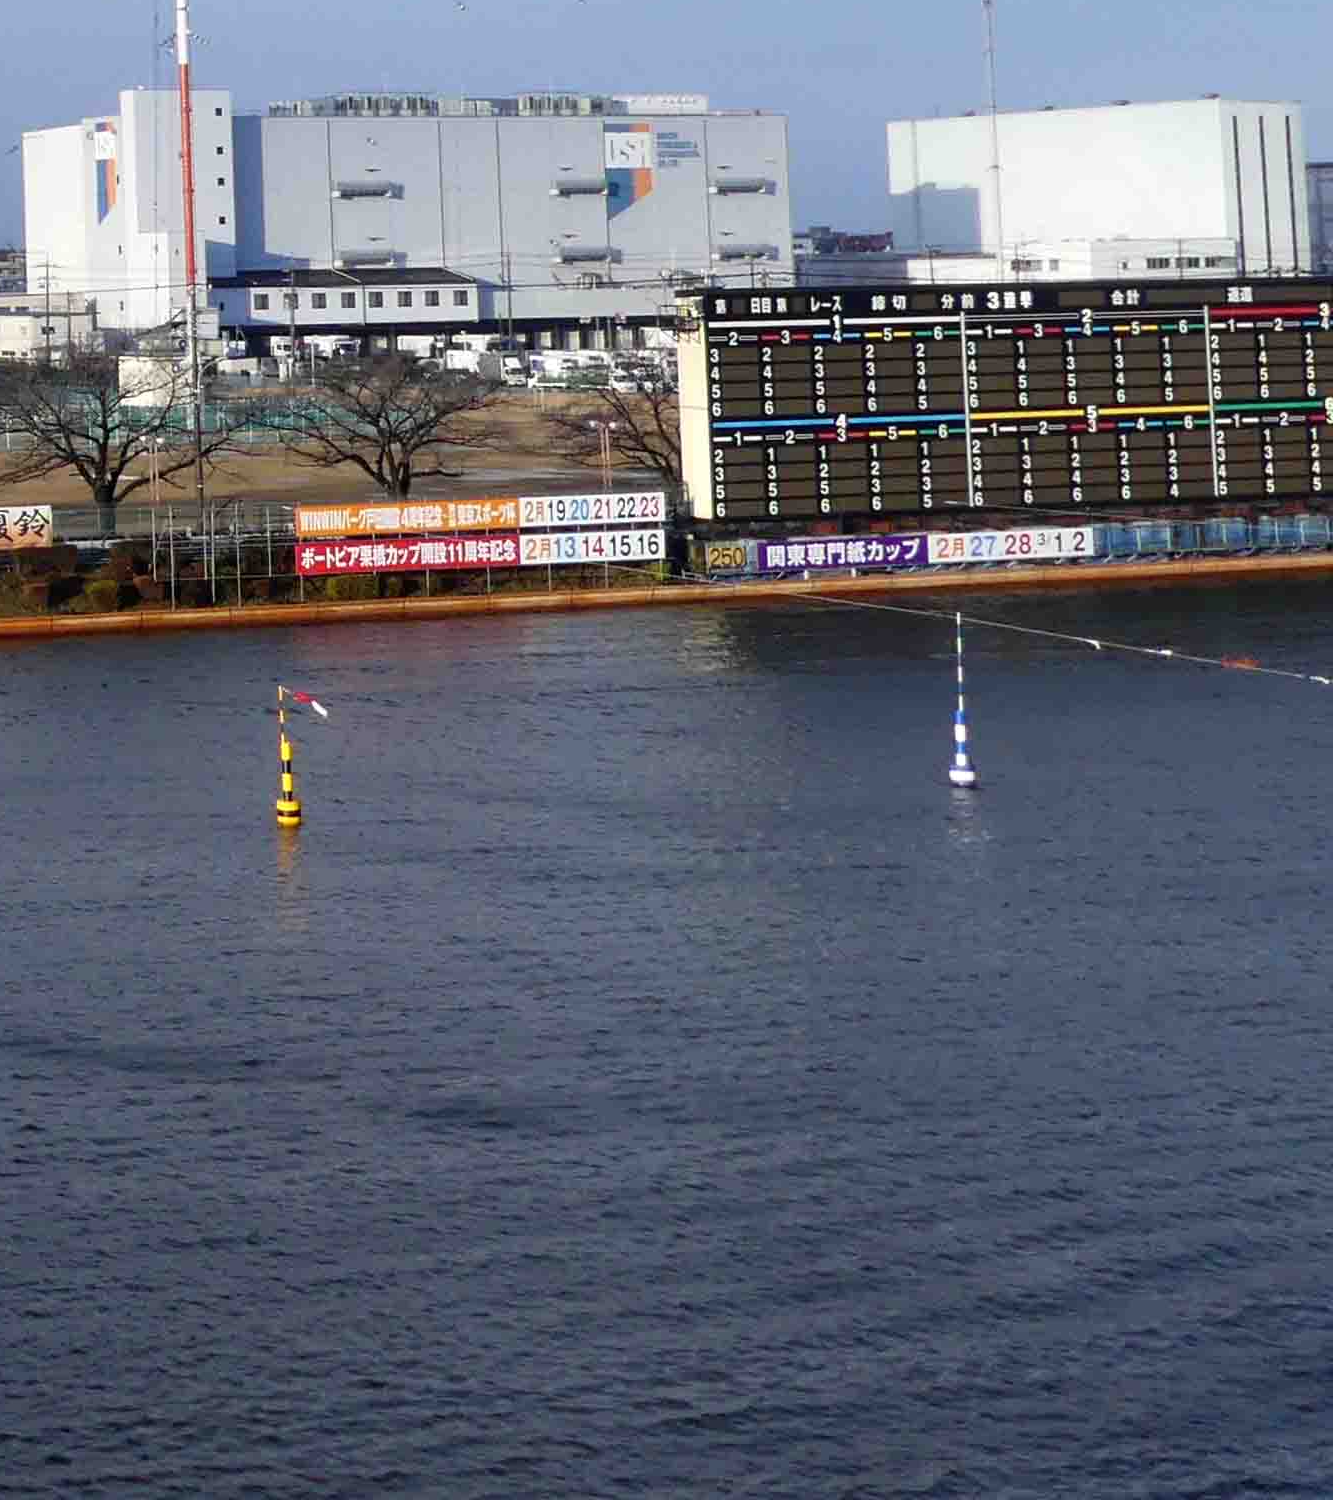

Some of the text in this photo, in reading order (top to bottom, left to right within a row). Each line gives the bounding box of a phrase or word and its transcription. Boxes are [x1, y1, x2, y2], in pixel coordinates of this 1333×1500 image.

[810, 296, 843, 313] レース
[1319, 302, 1330, 320] 3
[832, 314, 840, 330] 1
[1081, 308, 1092, 323] 2
[933, 325, 943, 341] 6
[985, 324, 992, 339] 1
[1034, 323, 1043, 338] 3
[1083, 322, 1092, 336] 4
[1131, 321, 1140, 335] 5
[1179, 319, 1188, 333] 6
[1228, 318, 1235, 333] 1
[729, 331, 738, 346] 2
[780, 330, 790, 344] 3
[832, 329, 842, 343] 4
[883, 327, 892, 341] 5
[1210, 334, 1219, 349] 2
[916, 343, 925, 358] 2
[967, 341, 976, 356] 3
[1017, 340, 1024, 354] 1
[1066, 339, 1073, 352] 1
[1114, 338, 1121, 352] 1
[1162, 337, 1169, 349] 1
[710, 348, 719, 363] 3
[762, 347, 772, 362] 2
[814, 345, 823, 360] 2
[865, 344, 874, 359] 2
[1211, 352, 1220, 365] 4
[968, 359, 977, 373] 4
[1017, 357, 1027, 371] 4
[1066, 355, 1076, 370] 3
[1115, 354, 1124, 369] 3
[1163, 353, 1172, 367] 3
[710, 366, 720, 381] 4
[763, 365, 773, 379] 4
[814, 363, 825, 378] 3
[866, 361, 875, 376] 3
[917, 361, 926, 376] 3
[1212, 368, 1222, 383] 5
[969, 376, 978, 390] 5
[1018, 374, 1027, 389] 5
[1067, 373, 1077, 387] 5
[1116, 371, 1125, 385] 4
[1164, 370, 1173, 384] 4
[711, 384, 721, 399] 5
[764, 382, 773, 397] 5
[816, 381, 825, 396] 5
[867, 379, 876, 394] 4
[917, 378, 927, 392] 4
[1213, 385, 1222, 400] 6
[969, 393, 979, 408] 6
[1019, 392, 1028, 406] 6
[1068, 390, 1077, 405] 6
[1116, 388, 1126, 403] 6
[1165, 387, 1174, 401] 5
[712, 402, 722, 417] 6
[764, 400, 774, 415] 6
[816, 398, 826, 414] 6
[867, 397, 877, 412] 6
[918, 395, 928, 410] 5
[1086, 405, 1098, 419] 5
[835, 413, 847, 429] 4
[1039, 420, 1048, 435] 2
[1088, 419, 1097, 433] 3
[1136, 417, 1145, 431] 4
[1184, 415, 1193, 429] 6
[1233, 413, 1240, 427] 1
[785, 429, 795, 444] 2
[837, 427, 847, 442] 3
[888, 426, 897, 440] 5
[938, 424, 948, 438] 6
[990, 422, 997, 437] 1
[734, 431, 741, 446] 1
[1022, 437, 1029, 451] 1
[1071, 435, 1078, 449] 1
[1120, 434, 1126, 448] 1
[1168, 432, 1175, 446] 1
[1216, 430, 1225, 445] 2
[819, 445, 826, 459] 1
[870, 443, 878, 457] 1
[921, 441, 928, 456] 1
[972, 439, 981, 454] 2
[714, 449, 724, 464] 2
[767, 447, 774, 462] 1
[1022, 454, 1031, 469] 3
[1071, 453, 1080, 467] 2
[1120, 451, 1129, 465] 2
[1168, 449, 1177, 464] 2
[1217, 447, 1226, 462] 3
[819, 463, 829, 478] 2
[870, 461, 880, 476] 2
[921, 459, 931, 474] 2
[972, 456, 982, 471] 3
[1218, 464, 1227, 478] 4
[715, 466, 724, 482] 3
[767, 465, 777, 480] 3
[1023, 472, 1032, 486] 4
[1072, 470, 1081, 483] 4
[1121, 467, 1130, 483] 3
[1169, 466, 1178, 481] 3
[820, 480, 830, 495] 5
[871, 478, 881, 493] 3
[922, 476, 932, 491] 3
[973, 474, 983, 488] 4
[1219, 481, 1228, 495] 5
[716, 484, 725, 499] 5
[768, 482, 778, 497] 5
[1024, 489, 1034, 504] 6
[1072, 487, 1082, 502] 6
[1121, 485, 1131, 499] 6
[1170, 483, 1179, 497] 4
[820, 498, 830, 513] 6
[872, 496, 882, 511] 6
[923, 494, 933, 508] 5
[974, 491, 984, 506] 6
[716, 502, 726, 517] 6
[769, 500, 779, 515] 6
[709, 547, 745, 565] 250
[766, 539, 921, 567] 関東専門紙カップ
